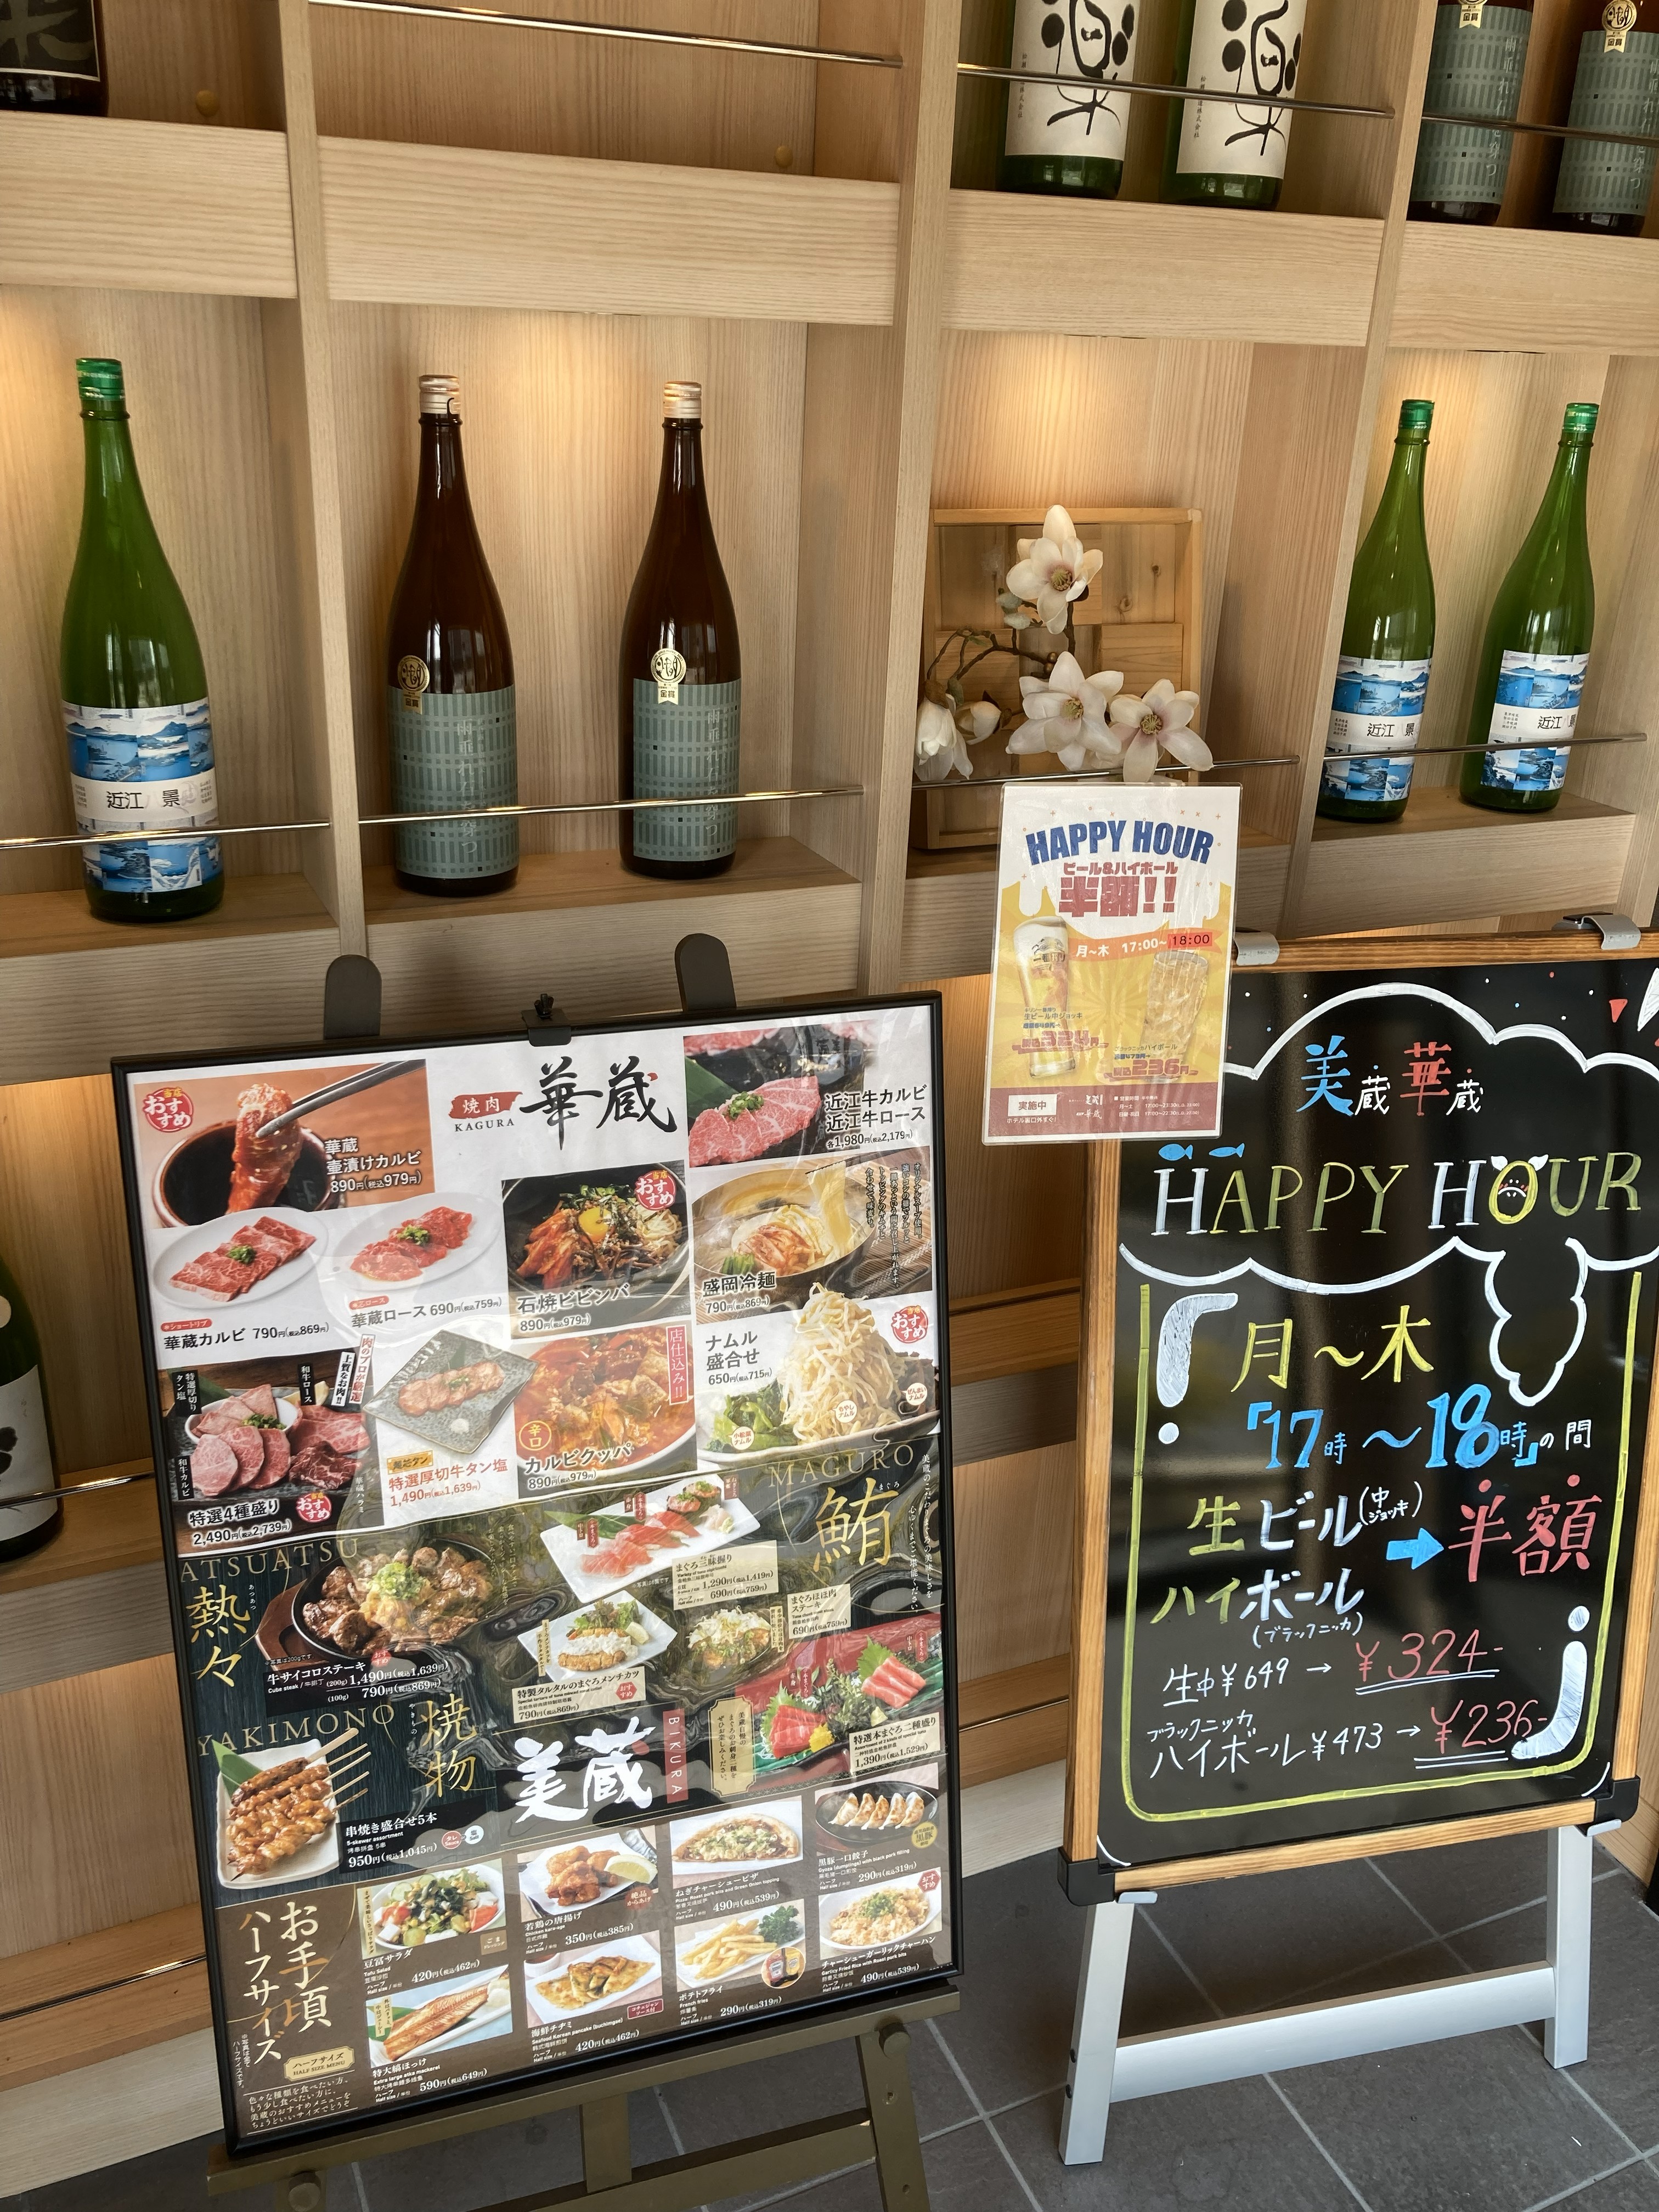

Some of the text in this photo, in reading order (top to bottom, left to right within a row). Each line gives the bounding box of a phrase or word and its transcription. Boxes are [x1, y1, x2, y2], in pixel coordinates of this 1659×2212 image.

[1025, 819, 1215, 866] HAPPY HOUR
[1063, 861, 1178, 876] ビール&ハイボール
[1059, 875, 1177, 917] 半額!!
[1172, 934, 1210, 946] 18:00
[462, 1096, 500, 1114] 焼肉
[518, 1056, 678, 1150] 華蔵
[825, 1084, 928, 1112] 近江牛カルビ
[1018, 1101, 1047, 1110] 実施中
[454, 1118, 515, 1132] KAGURA
[826, 1105, 926, 1132] 近江牛ロース
[324, 1138, 358, 1154] 華蔵
[330, 1170, 422, 1193] 890円(税込979円)
[1150, 1152, 1643, 1236] HAPPY HOUR
[703, 1271, 776, 1298] 盛岡冷麺
[351, 1296, 503, 1328] 華蔵ロース 690円(税込759円)
[517, 1283, 630, 1315] 石焼ビビンバ
[705, 1296, 770, 1315] 790円(税込869円)
[163, 1322, 330, 1350] 華蔵カルビ 790円(税込869円)
[519, 1315, 592, 1332] 890円(税込979円)
[706, 1330, 758, 1352] ナムル
[706, 1350, 760, 1372] 盛合せ
[176, 1374, 187, 1401] タン塩
[301, 1365, 313, 1404] 和牛ロース
[708, 1367, 773, 1385] 650円(税込715円)
[528, 1423, 545, 1447] 辛口
[524, 1443, 633, 1475] カルビクッパ
[768, 1444, 915, 1488] MAGURO
[178, 1458, 190, 1498] 和牛カルビ
[388, 1458, 509, 1492] 特選厚切牛タン塩
[527, 1469, 597, 1491] 890円(税込979円)
[879, 1481, 900, 1491] まぐろ
[189, 1498, 279, 1527] 特選4種盛り
[814, 1476, 900, 1572] 鮪
[193, 1519, 293, 1547] 2,490円(税込2,739円)
[1448, 1493, 1603, 1583] 半額
[180, 1538, 359, 1583] ATSUATSU
[791, 1589, 837, 1605] まぐろほほ肉
[791, 1601, 822, 1613] ステーキ
[1150, 1567, 1365, 1624] ハイボール
[186, 1583, 251, 1688] 熱々
[267, 1660, 366, 1686] 牛サイコロステーキ
[326, 1679, 348, 1688] (200g)
[517, 1671, 640, 1699] 特製タルタルのまぐろメンチカツ
[328, 1694, 349, 1702] (100g)
[198, 1703, 396, 1757] YAKIMONO
[853, 1717, 936, 1745] 特選本まぐろ二種盛り
[1147, 1709, 1254, 1743] ブラックニッカ
[419, 1692, 479, 1798] 焼物
[668, 1716, 683, 1796] BIKURA
[514, 1716, 657, 1824] 美蔵
[345, 1812, 438, 1838] 串焼き盛合せ5本
[373, 1831, 404, 1843] assortment
[675, 1872, 759, 1898] ねぎチャーシューピザ
[278, 1901, 332, 2034] お手頃
[239, 1910, 285, 2066] ハーフサイズ
[679, 1985, 724, 2001] ポテトフライ
[292, 2052, 345, 2069] ハーフサイズ
[293, 2060, 346, 2076] HALF SIZE MENU
